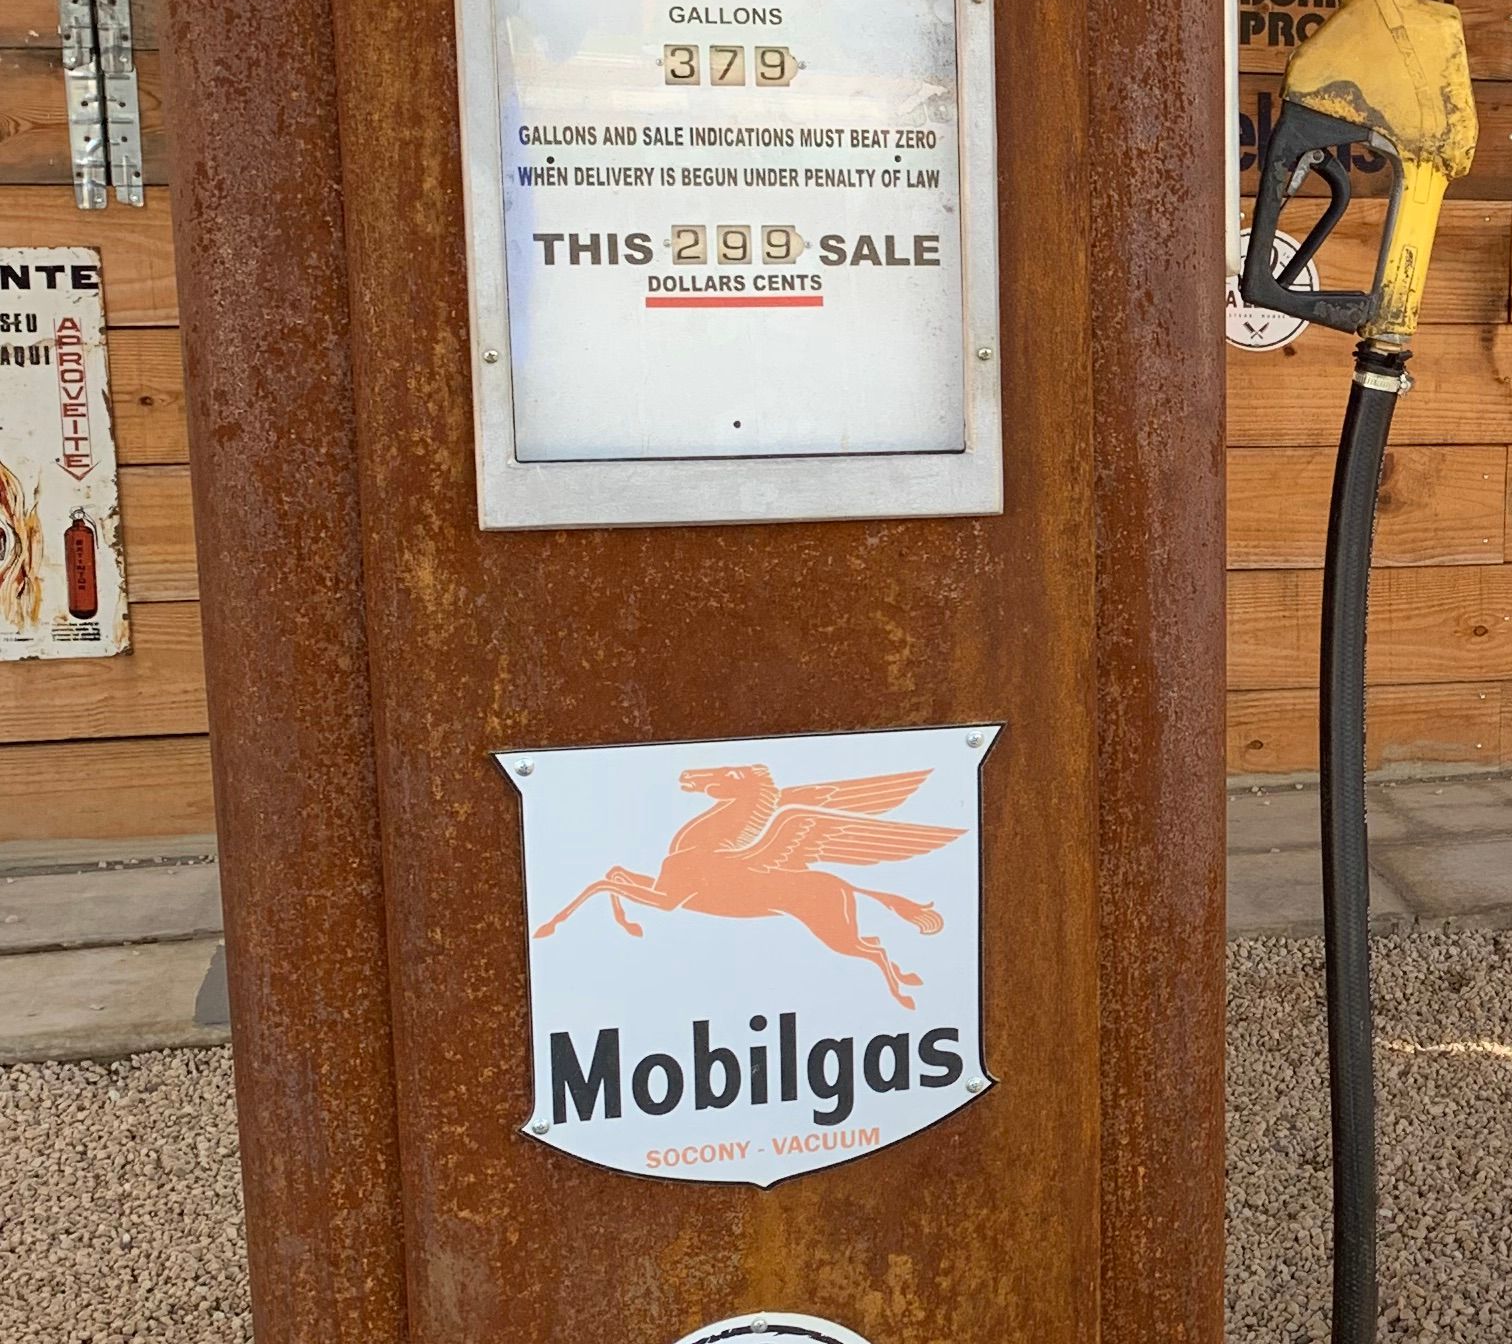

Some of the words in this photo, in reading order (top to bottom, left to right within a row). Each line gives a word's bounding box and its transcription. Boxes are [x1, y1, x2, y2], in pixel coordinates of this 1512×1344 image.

[669, 6, 783, 25] GALLONS
[519, 126, 597, 146] GALLONS
[603, 127, 637, 146] AND
[643, 127, 684, 147] SALE
[690, 127, 794, 148] INDICATIONS
[800, 129, 844, 148] MUST
[895, 130, 936, 149] ZERO
[518, 166, 568, 187] WHEN
[574, 166, 655, 187] DELIVERY
[660, 167, 676, 187] IS
[681, 167, 738, 187] BEGUN
[744, 167, 799, 187] UNDER
[804, 168, 876, 188] PENALTY
[881, 168, 902, 188] OF
[907, 169, 940, 189] LAW
[533, 233, 653, 266] THIS
[819, 233, 941, 267] SALE
[0, 265, 99, 290] NTE
[648, 274, 746, 292] DOLLARS
[753, 273, 823, 292] CENTS
[0, 313, 37, 333] SEU
[0, 345, 50, 368] AQUI
[57, 317, 90, 468] APROVEITE
[549, 1012, 964, 1126] Mobilgas
[646, 1141, 750, 1169] SOCONY
[772, 1128, 881, 1155] VACUUM
